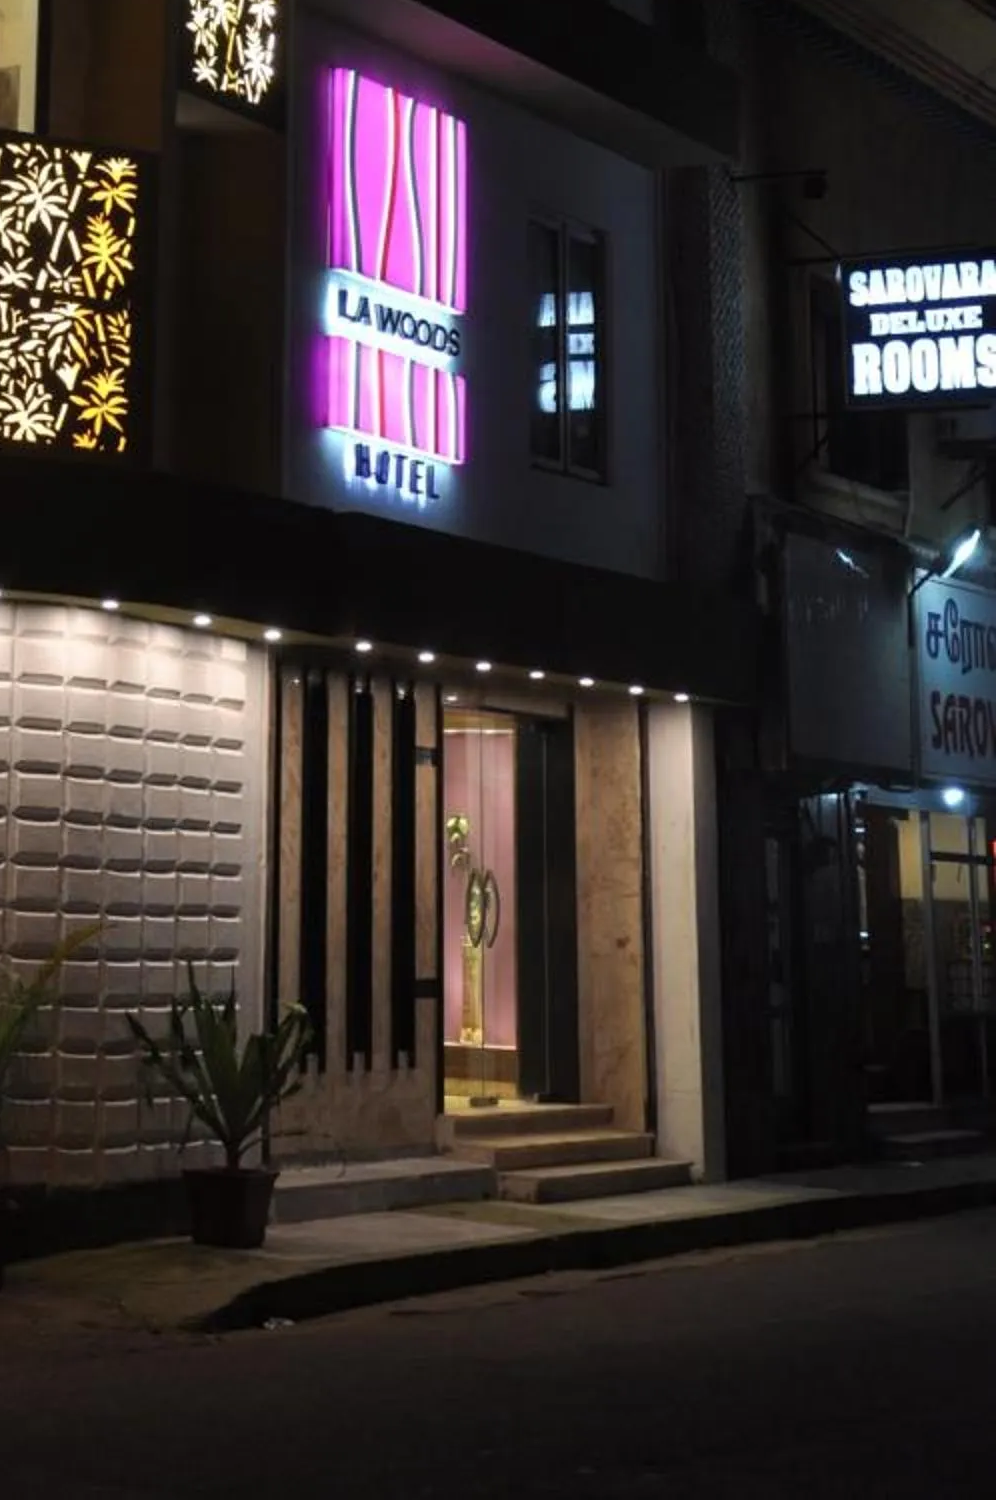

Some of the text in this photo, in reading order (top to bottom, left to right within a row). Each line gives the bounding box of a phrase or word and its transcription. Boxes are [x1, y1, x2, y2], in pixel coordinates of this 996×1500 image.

[338, 289, 460, 357] LA WOODS
[869, 306, 983, 336] DELUXE
[852, 334, 996, 395] ROOMS
[354, 443, 440, 499] HOTEL
